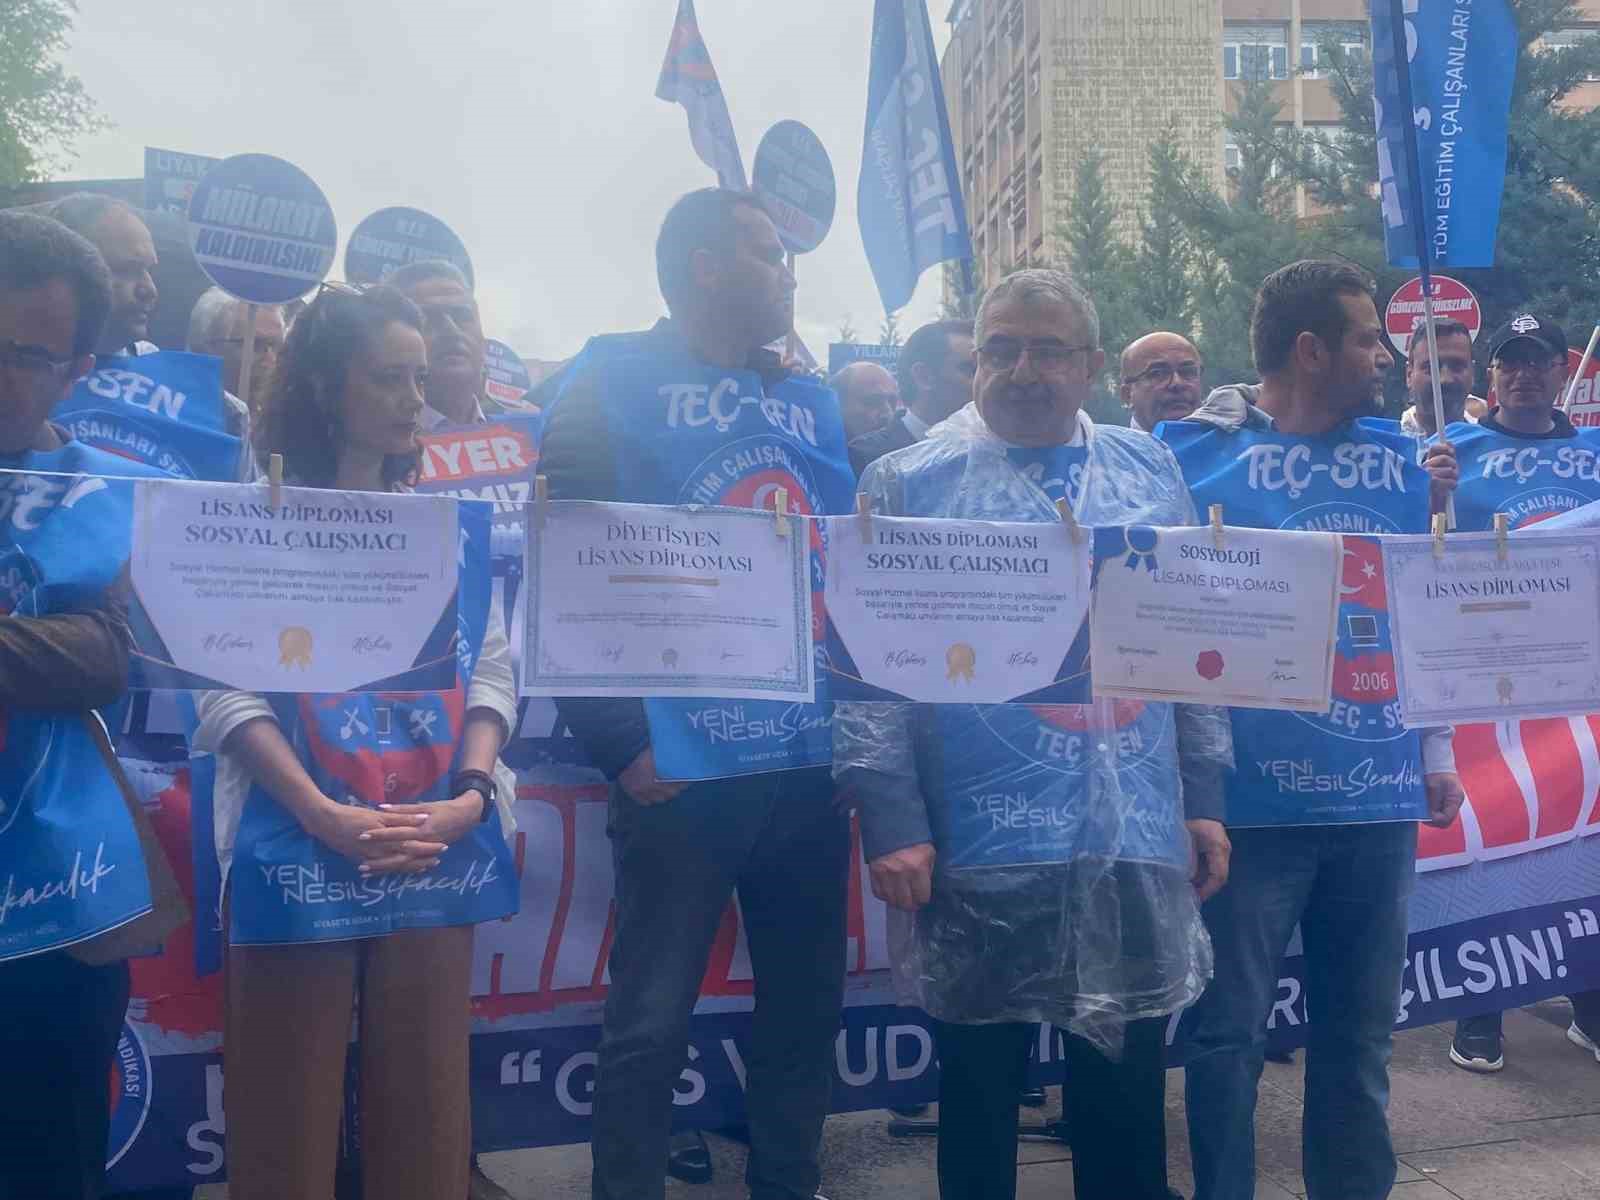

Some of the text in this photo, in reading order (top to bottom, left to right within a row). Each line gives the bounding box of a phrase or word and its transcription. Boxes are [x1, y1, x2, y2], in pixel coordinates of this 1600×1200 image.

[1440, 10, 1472, 137] ÇALIŞANLARI
[1433, 141, 1456, 209] EĞİTİM
[1432, 214, 1449, 260] TÜM
[1248, 441, 1408, 499] TEÇ-SEN
[200, 499, 394, 526] LİSANS DİPLOMASI
[184, 523, 408, 555] SOSYAL ÇALIŞMACI
[606, 520, 722, 547] DİYETİSYEN
[879, 529, 1041, 550] LİSANS DİPLOMASI
[577, 545, 753, 573] LİSANS DİPLOMASI
[866, 552, 1049, 576] SOSYAL ÇALIŞMACI
[1180, 543, 1262, 567] SOSYOLOJİ
[1425, 576, 1571, 600] LİSANS DİPLOMASI
[1351, 672, 1390, 691] 2006
